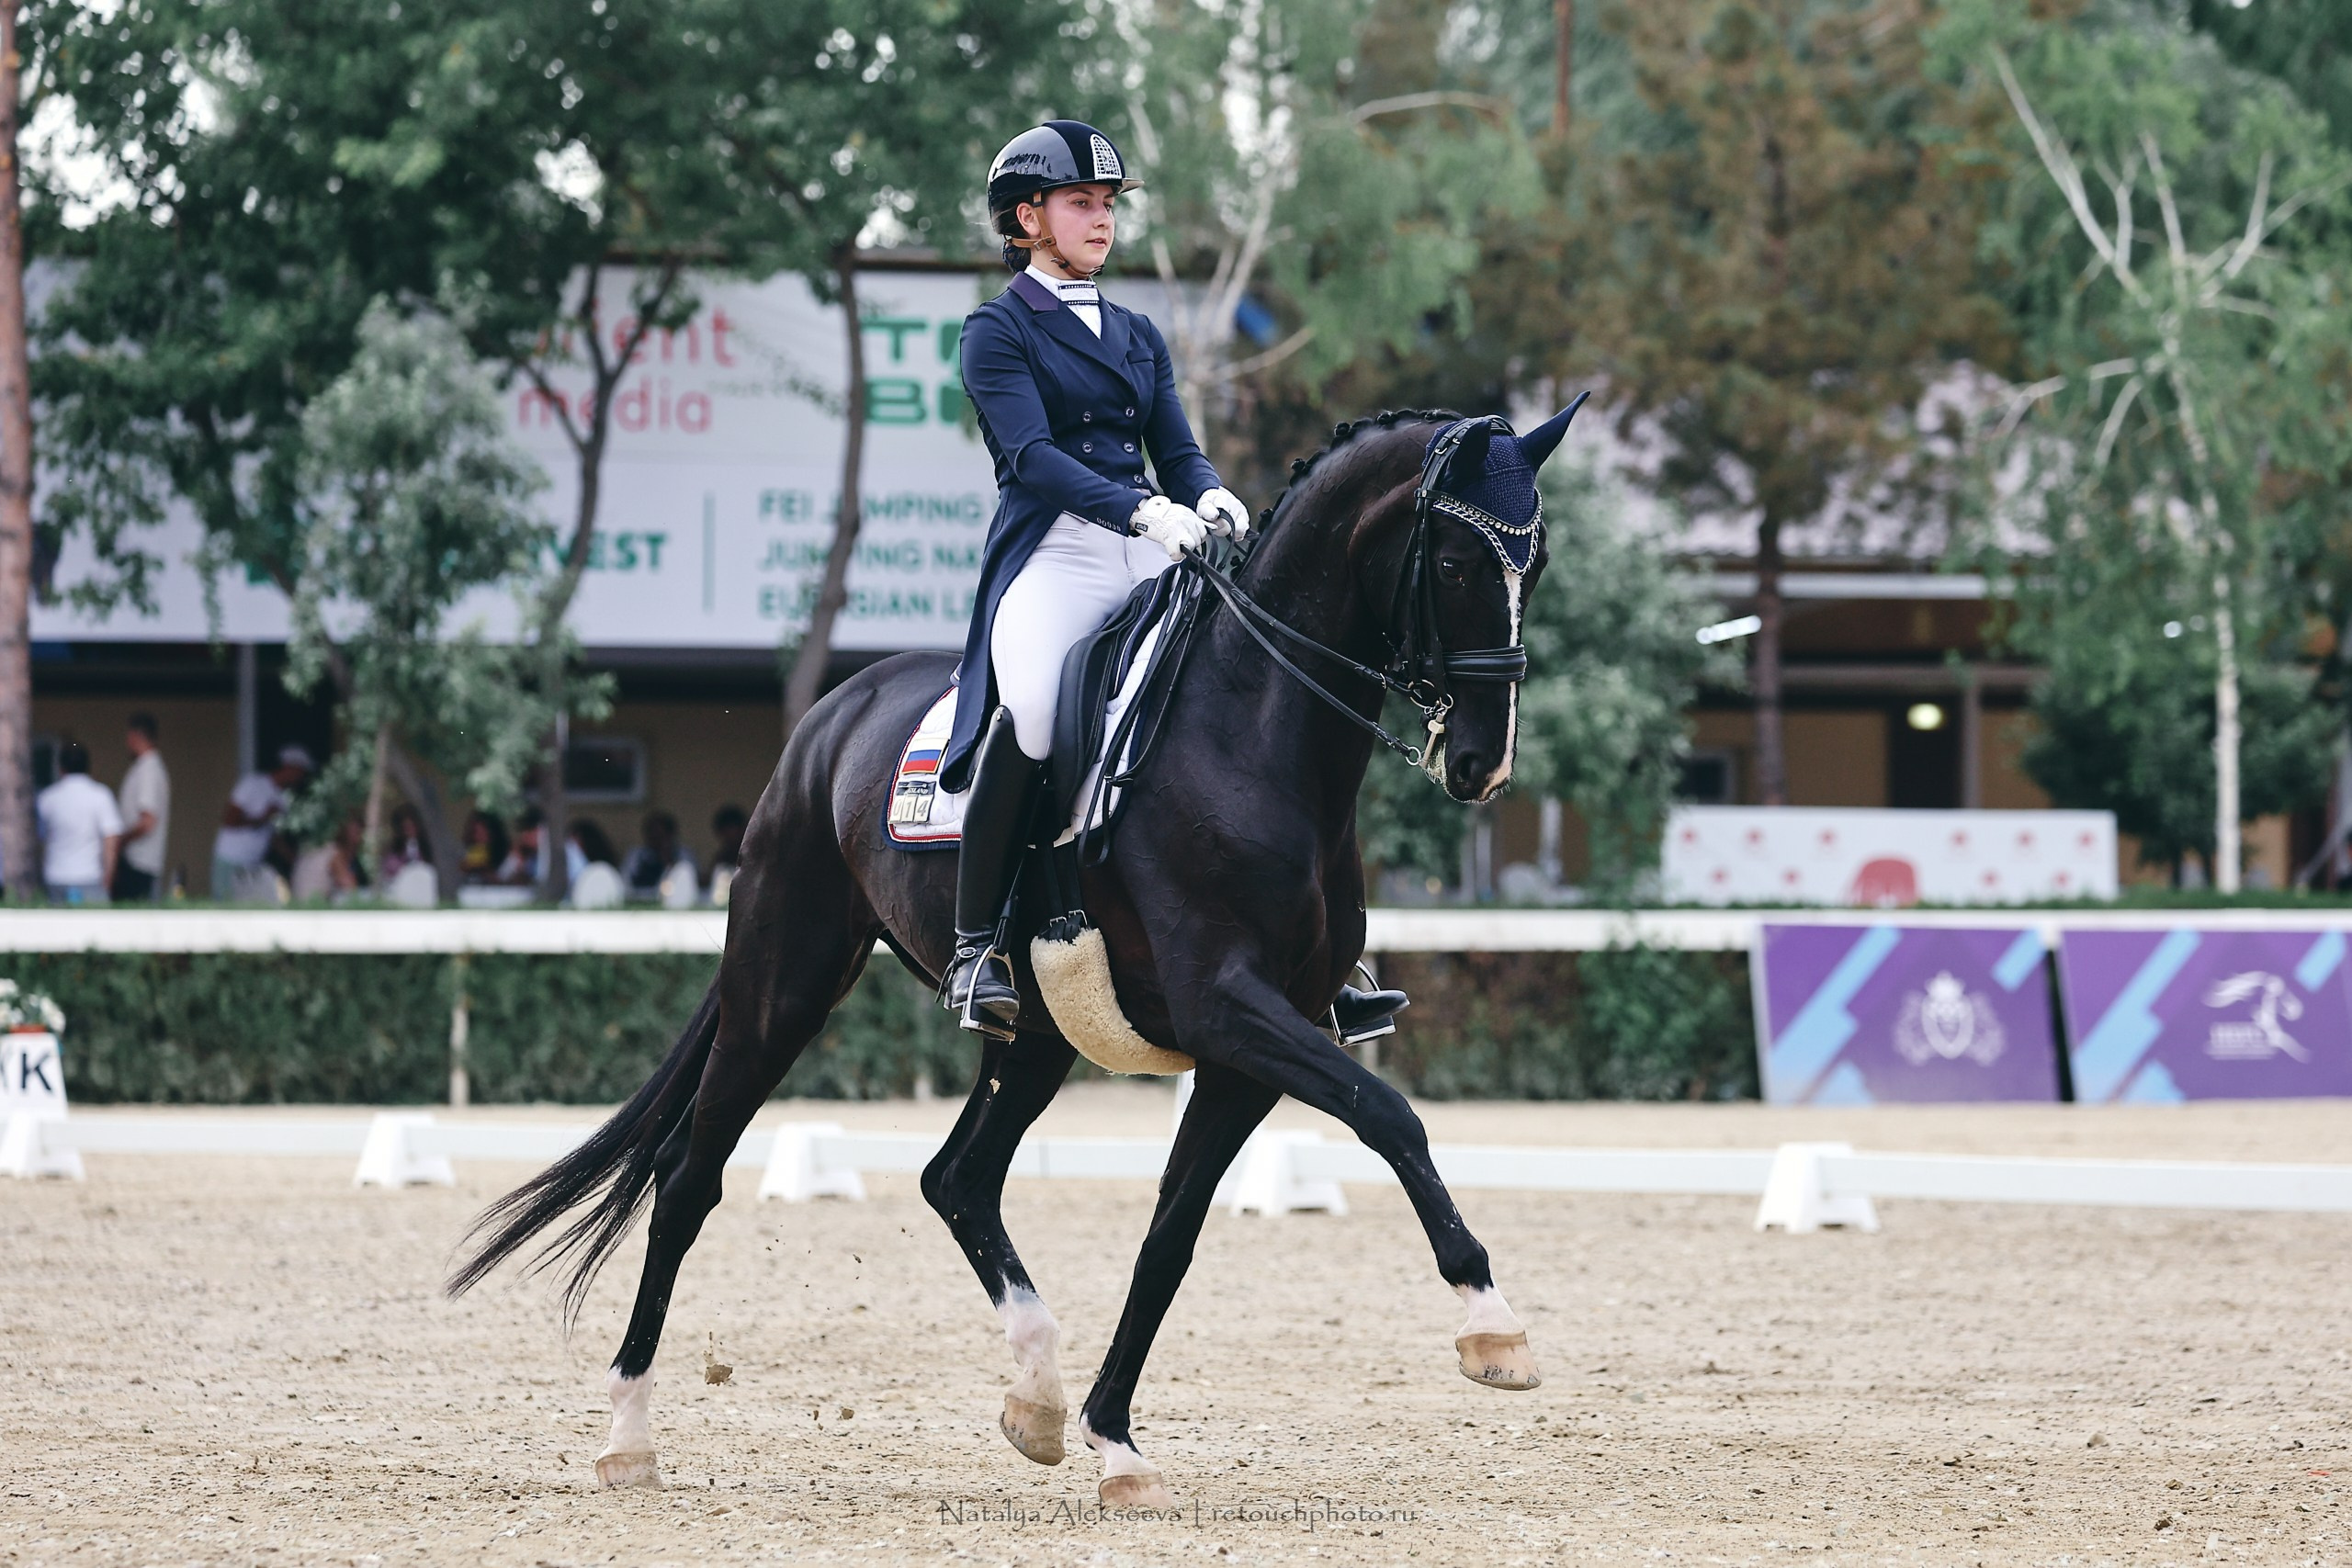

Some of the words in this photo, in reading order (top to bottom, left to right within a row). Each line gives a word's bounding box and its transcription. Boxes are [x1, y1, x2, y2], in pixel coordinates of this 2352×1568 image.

[759, 491, 812, 523] FEI
[824, 493, 983, 527] JMPING
[760, 538, 922, 570] JUMING
[893, 798, 928, 818] 014
[20, 1050, 51, 1092] K
